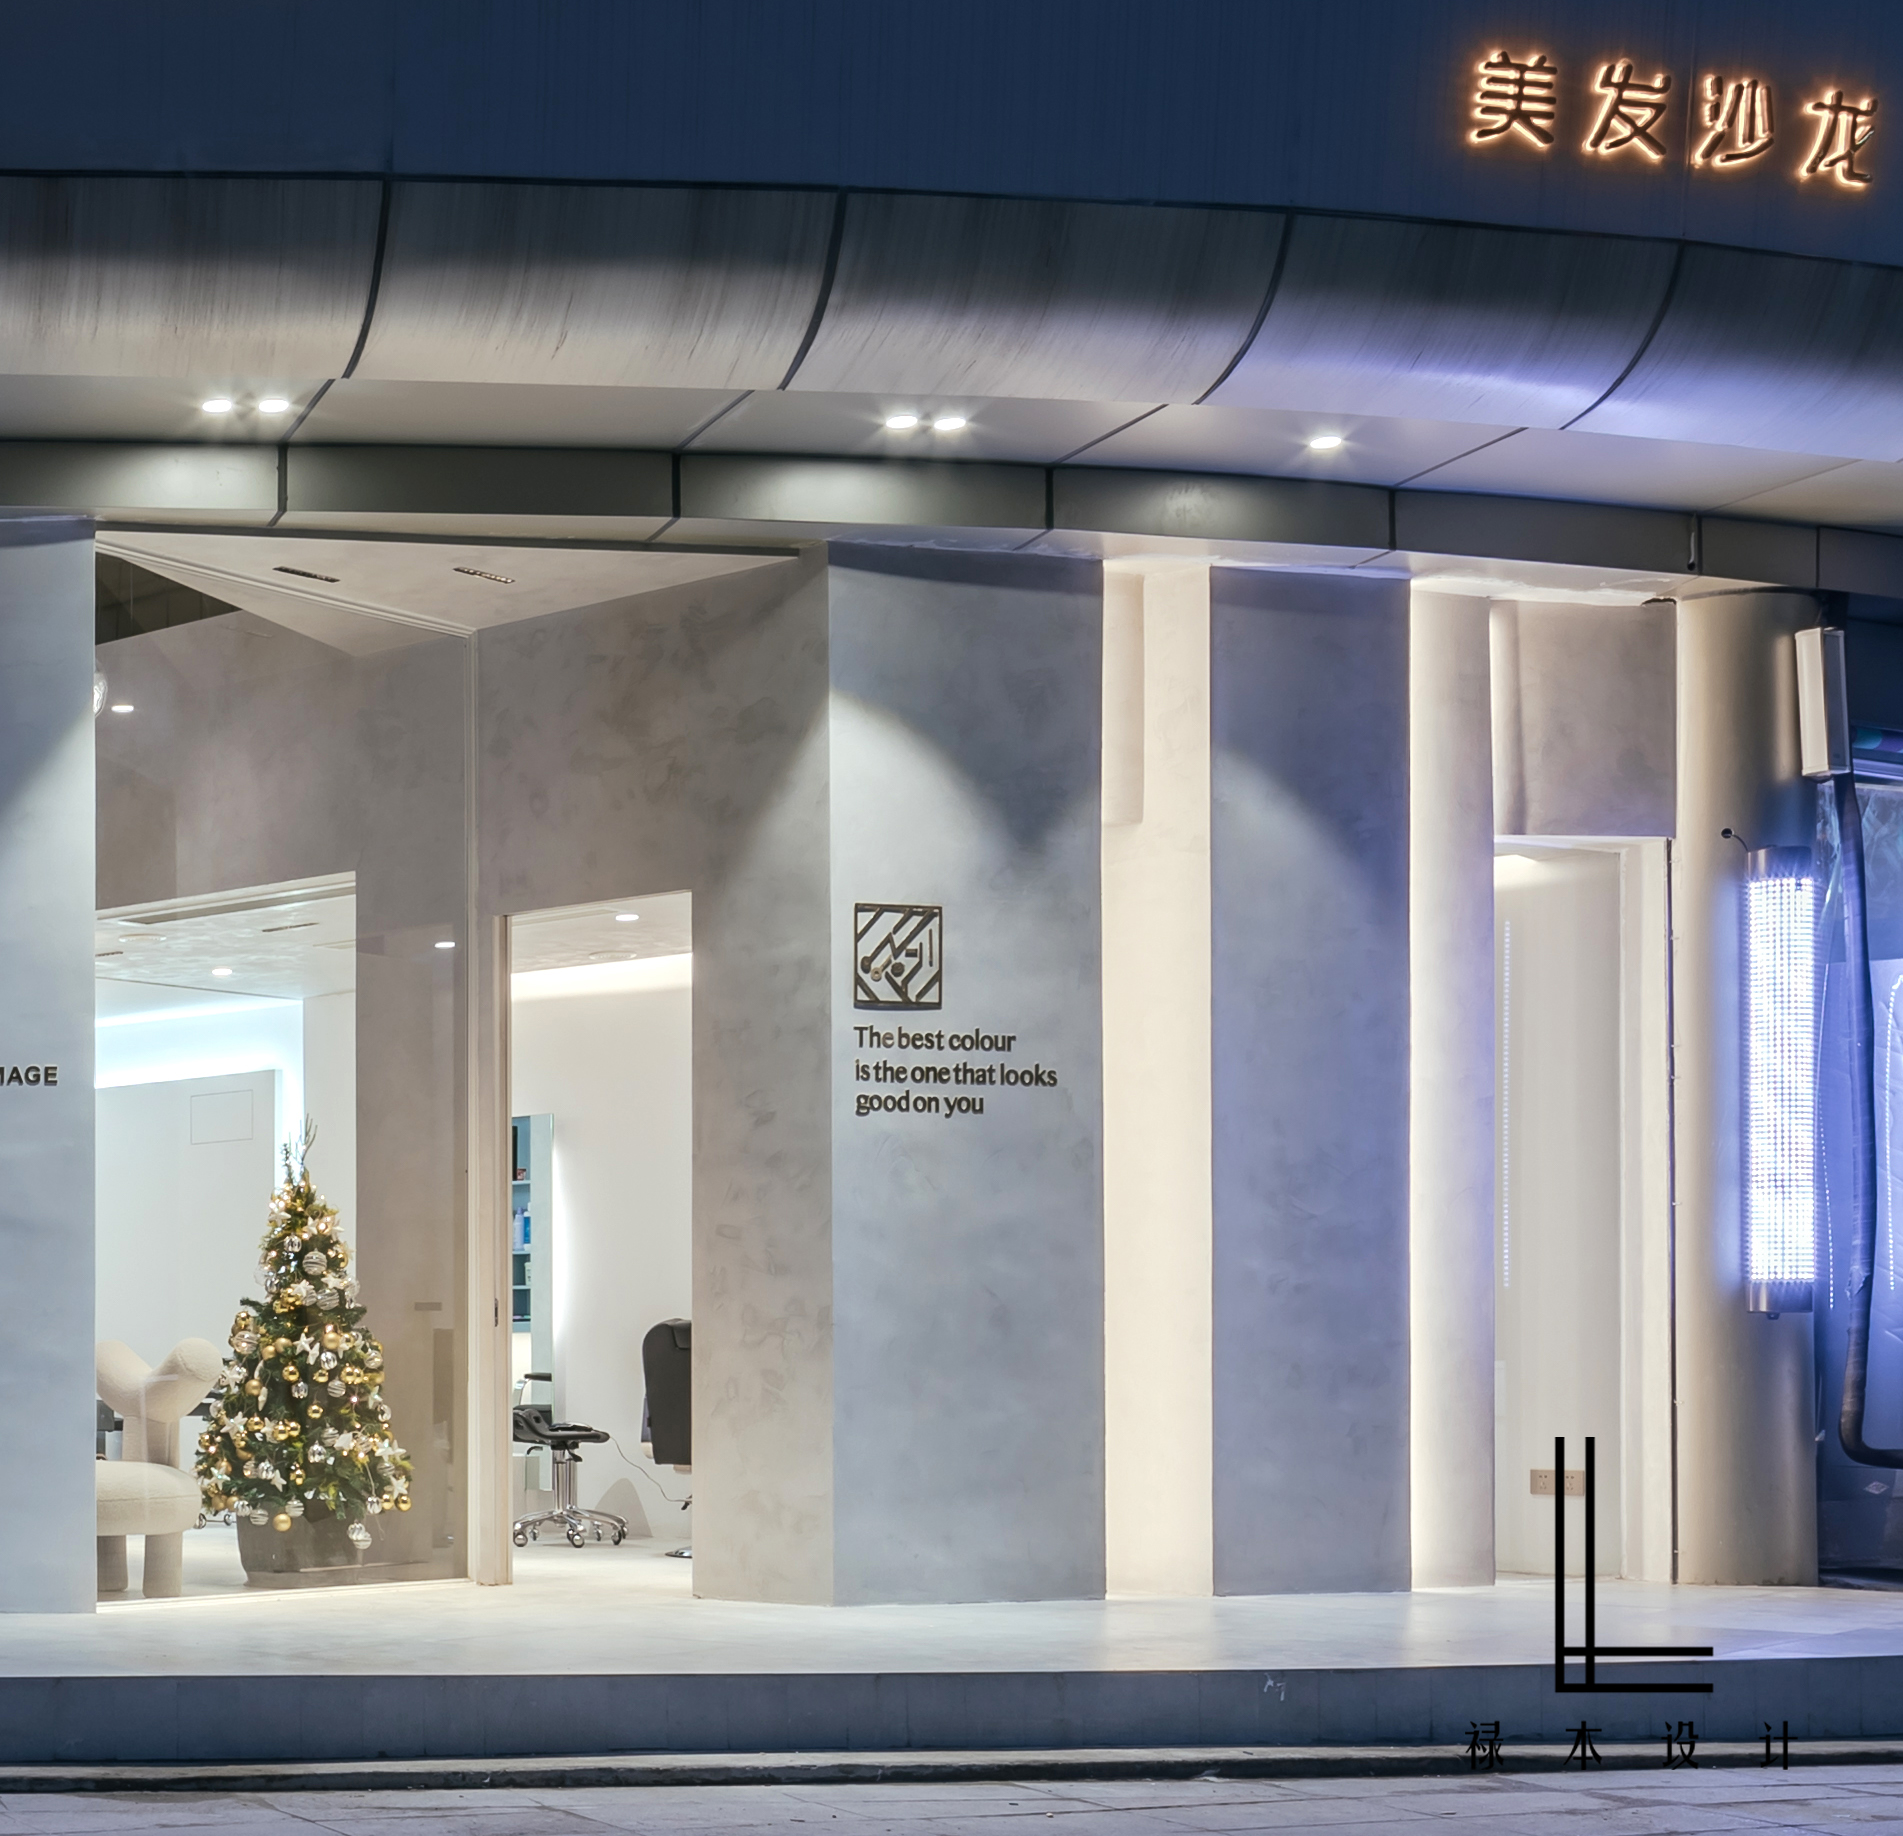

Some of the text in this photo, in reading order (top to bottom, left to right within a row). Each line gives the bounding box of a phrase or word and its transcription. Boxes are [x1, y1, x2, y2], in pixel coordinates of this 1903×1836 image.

[1469, 50, 1878, 186] 美发沙龙
[854, 1024, 1016, 1052] The best colour
[855, 1059, 1058, 1087] is the one that looks
[855, 1090, 984, 1119] good on you
